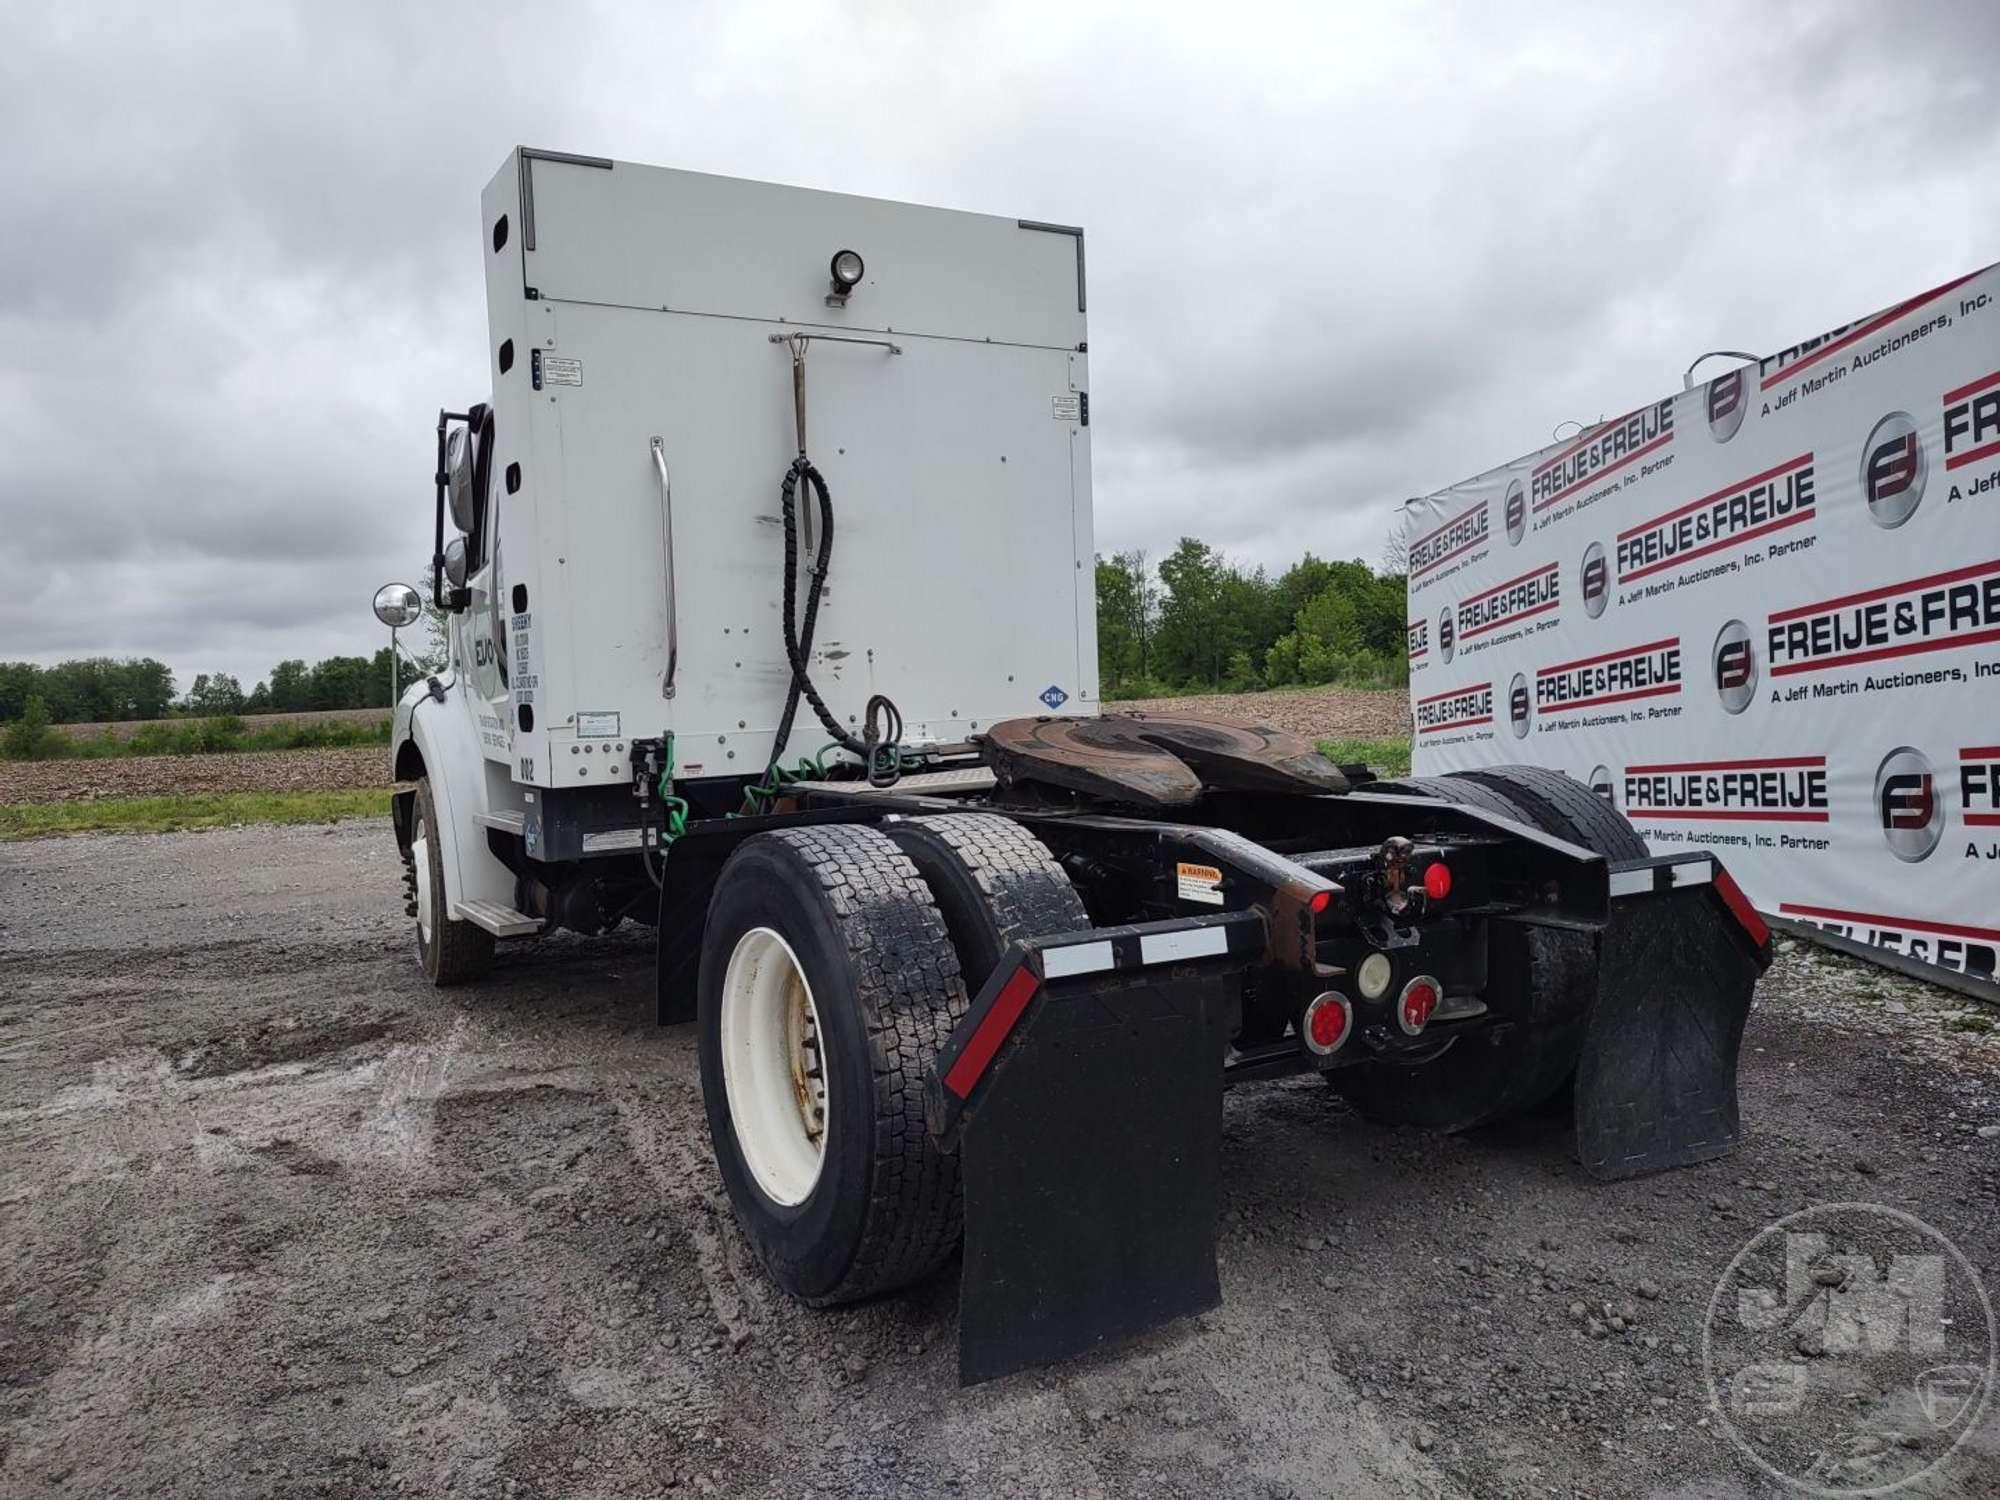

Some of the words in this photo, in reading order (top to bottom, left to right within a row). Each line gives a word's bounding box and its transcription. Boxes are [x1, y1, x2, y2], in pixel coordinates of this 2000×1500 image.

[1761, 403, 1771, 418] A
[1774, 389, 1797, 411] Jeff
[1802, 367, 1847, 397] Martin
[1852, 313, 1953, 373] Auctioneers,
[1960, 292, 1993, 317] Inc.
[1947, 485, 1962, 503] A
[1618, 595, 1625, 607] A
[1628, 588, 1643, 604] Jeff
[1645, 579, 1675, 599] Martin
[1744, 552, 1765, 568] Inc.
[1769, 535, 1817, 560] Partner
[1771, 690, 1782, 704] A
[1784, 686, 1808, 702] Jeff
[1812, 680, 1858, 699] Martin
[1864, 667, 1968, 692] Auctioneers,
[1648, 706, 1683, 720] Partner
[1654, 830, 1684, 843] Martin
[1686, 830, 1752, 848] Auctioneers,
[1755, 833, 1777, 848] Inc.
[1780, 834, 1831, 850] Partner
[1965, 842, 1980, 858] A
